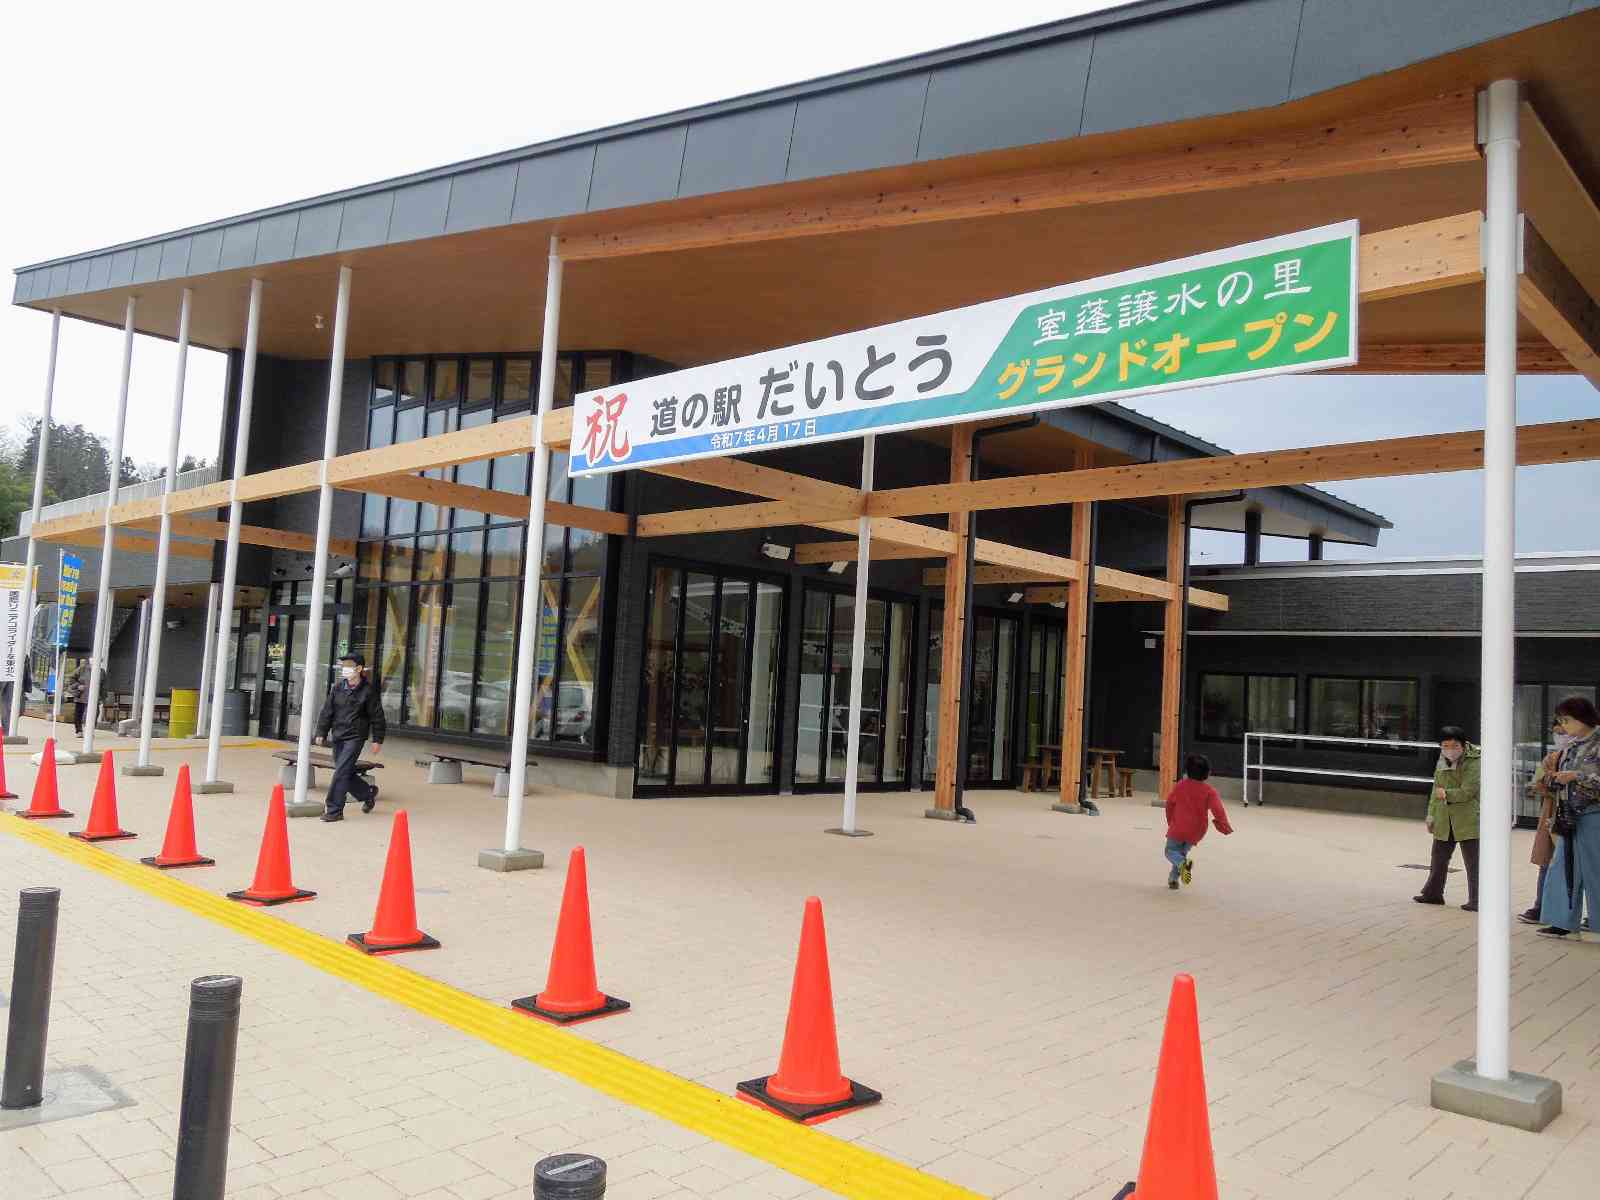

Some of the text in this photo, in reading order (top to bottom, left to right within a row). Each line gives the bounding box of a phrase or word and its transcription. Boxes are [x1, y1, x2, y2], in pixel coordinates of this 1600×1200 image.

[1033, 258, 1312, 347] 室蓬譲水の里
[650, 334, 953, 437] 道の駅 だいとう
[997, 311, 1339, 400] グランドオープン
[582, 394, 629, 463] 祝
